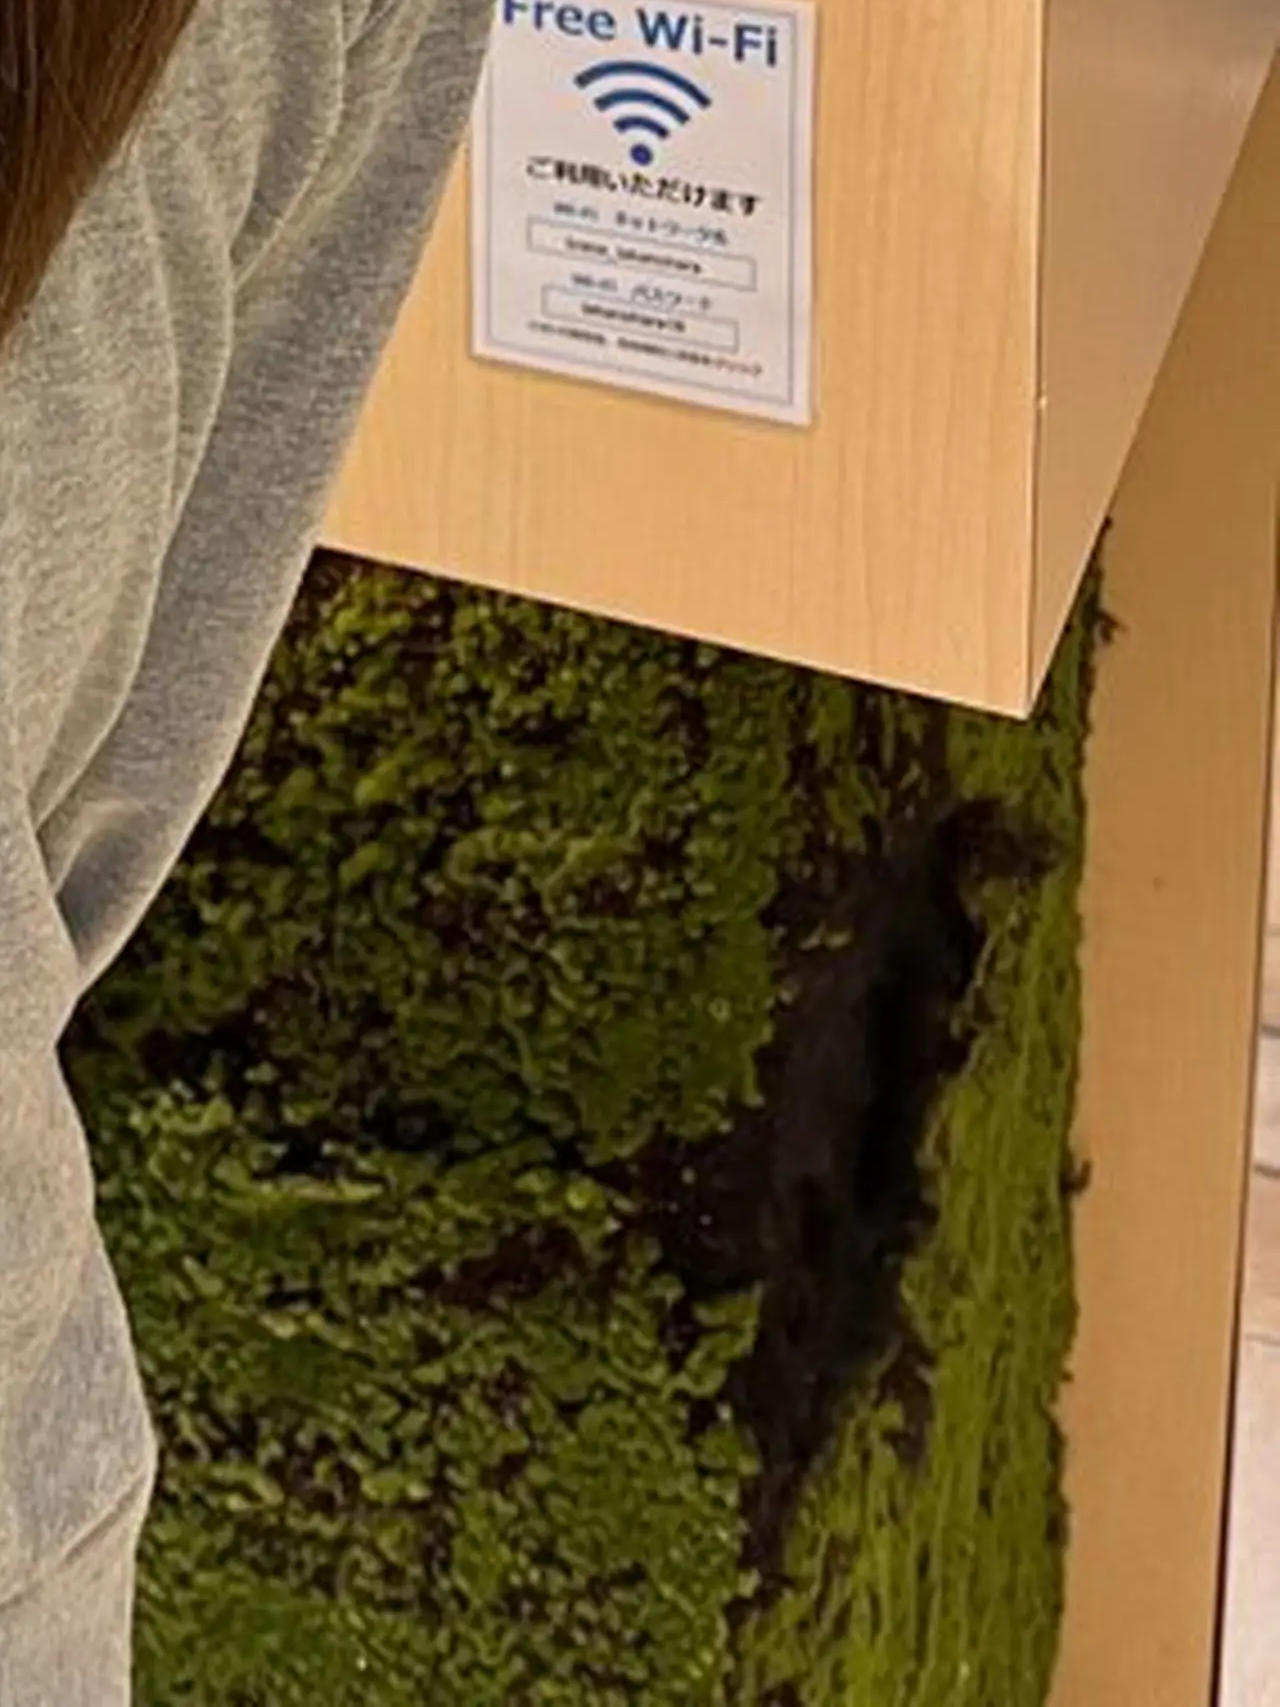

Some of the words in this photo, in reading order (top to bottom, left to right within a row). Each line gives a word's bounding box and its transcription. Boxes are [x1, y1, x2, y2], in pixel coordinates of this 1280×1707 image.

[636, 7, 778, 68] Wi-Fi
[526, 155, 764, 216] ご利用いただけます
